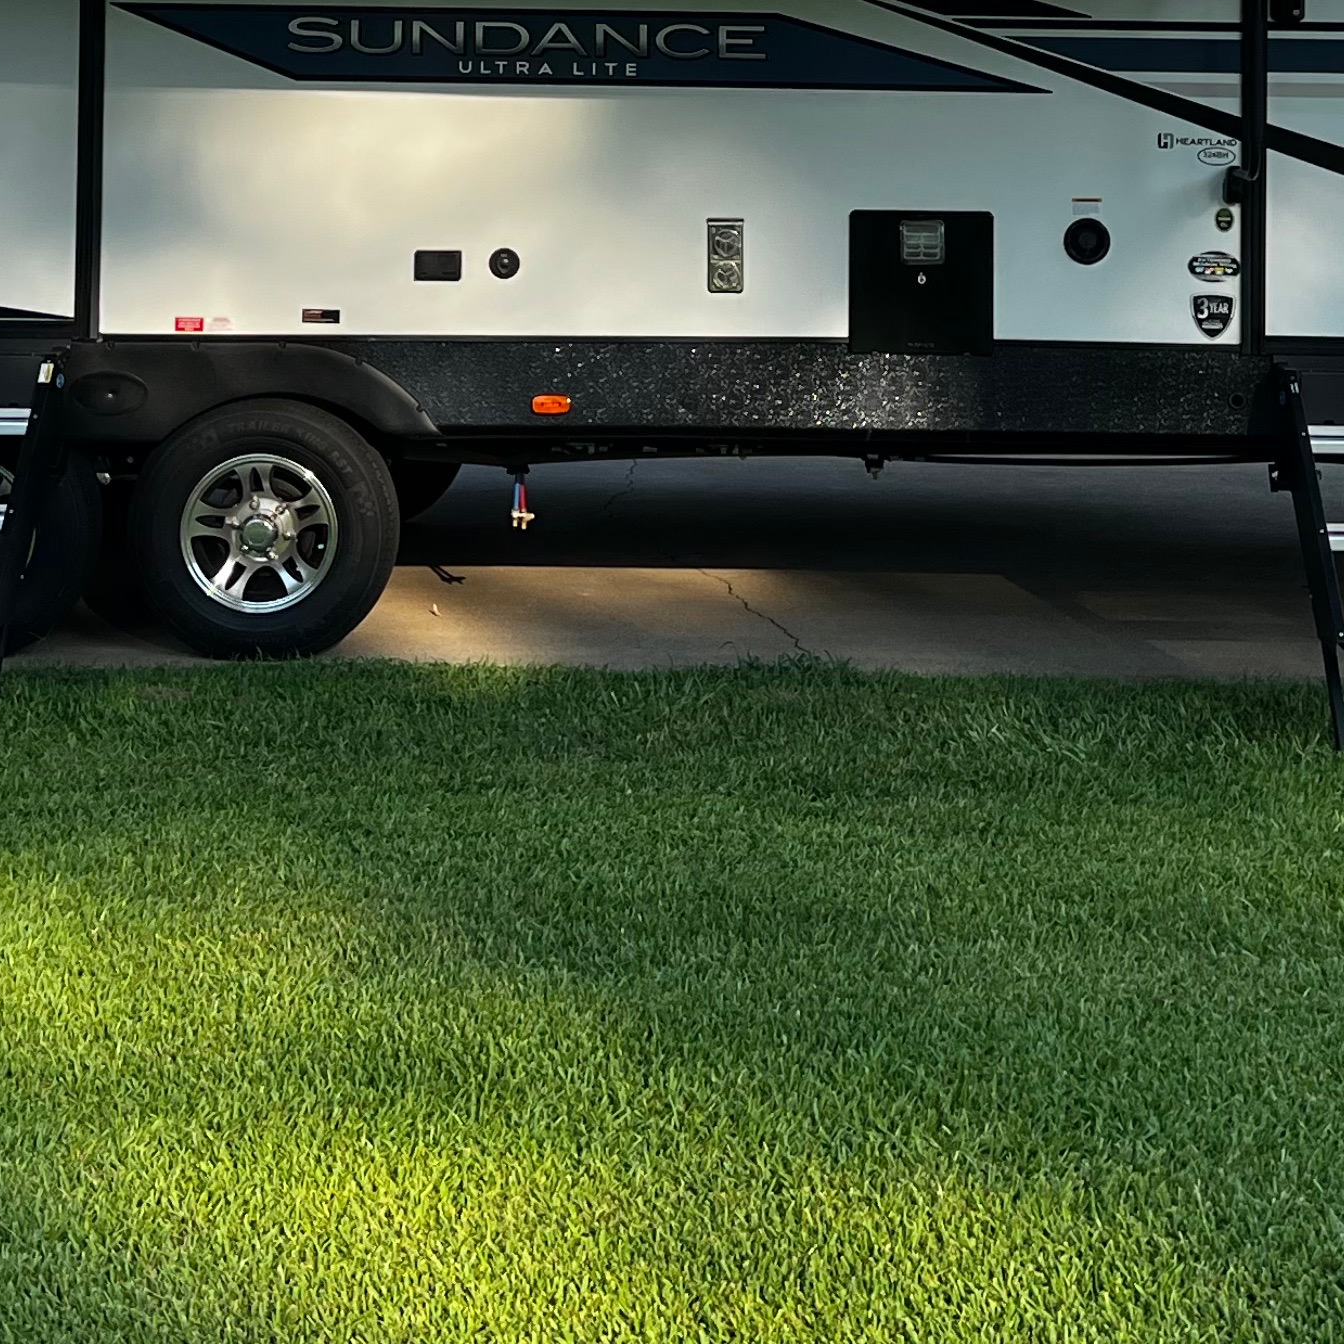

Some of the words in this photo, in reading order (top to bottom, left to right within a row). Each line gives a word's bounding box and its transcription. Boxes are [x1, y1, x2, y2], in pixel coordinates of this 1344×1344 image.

[287, 16, 766, 59] SUNDANCE
[458, 60, 553, 76] ULTRA
[572, 62, 638, 77] LITE
[1176, 137, 1238, 147] HEARTLAND
[1197, 297, 1209, 319] 3
[1209, 302, 1229, 314] YEAR
